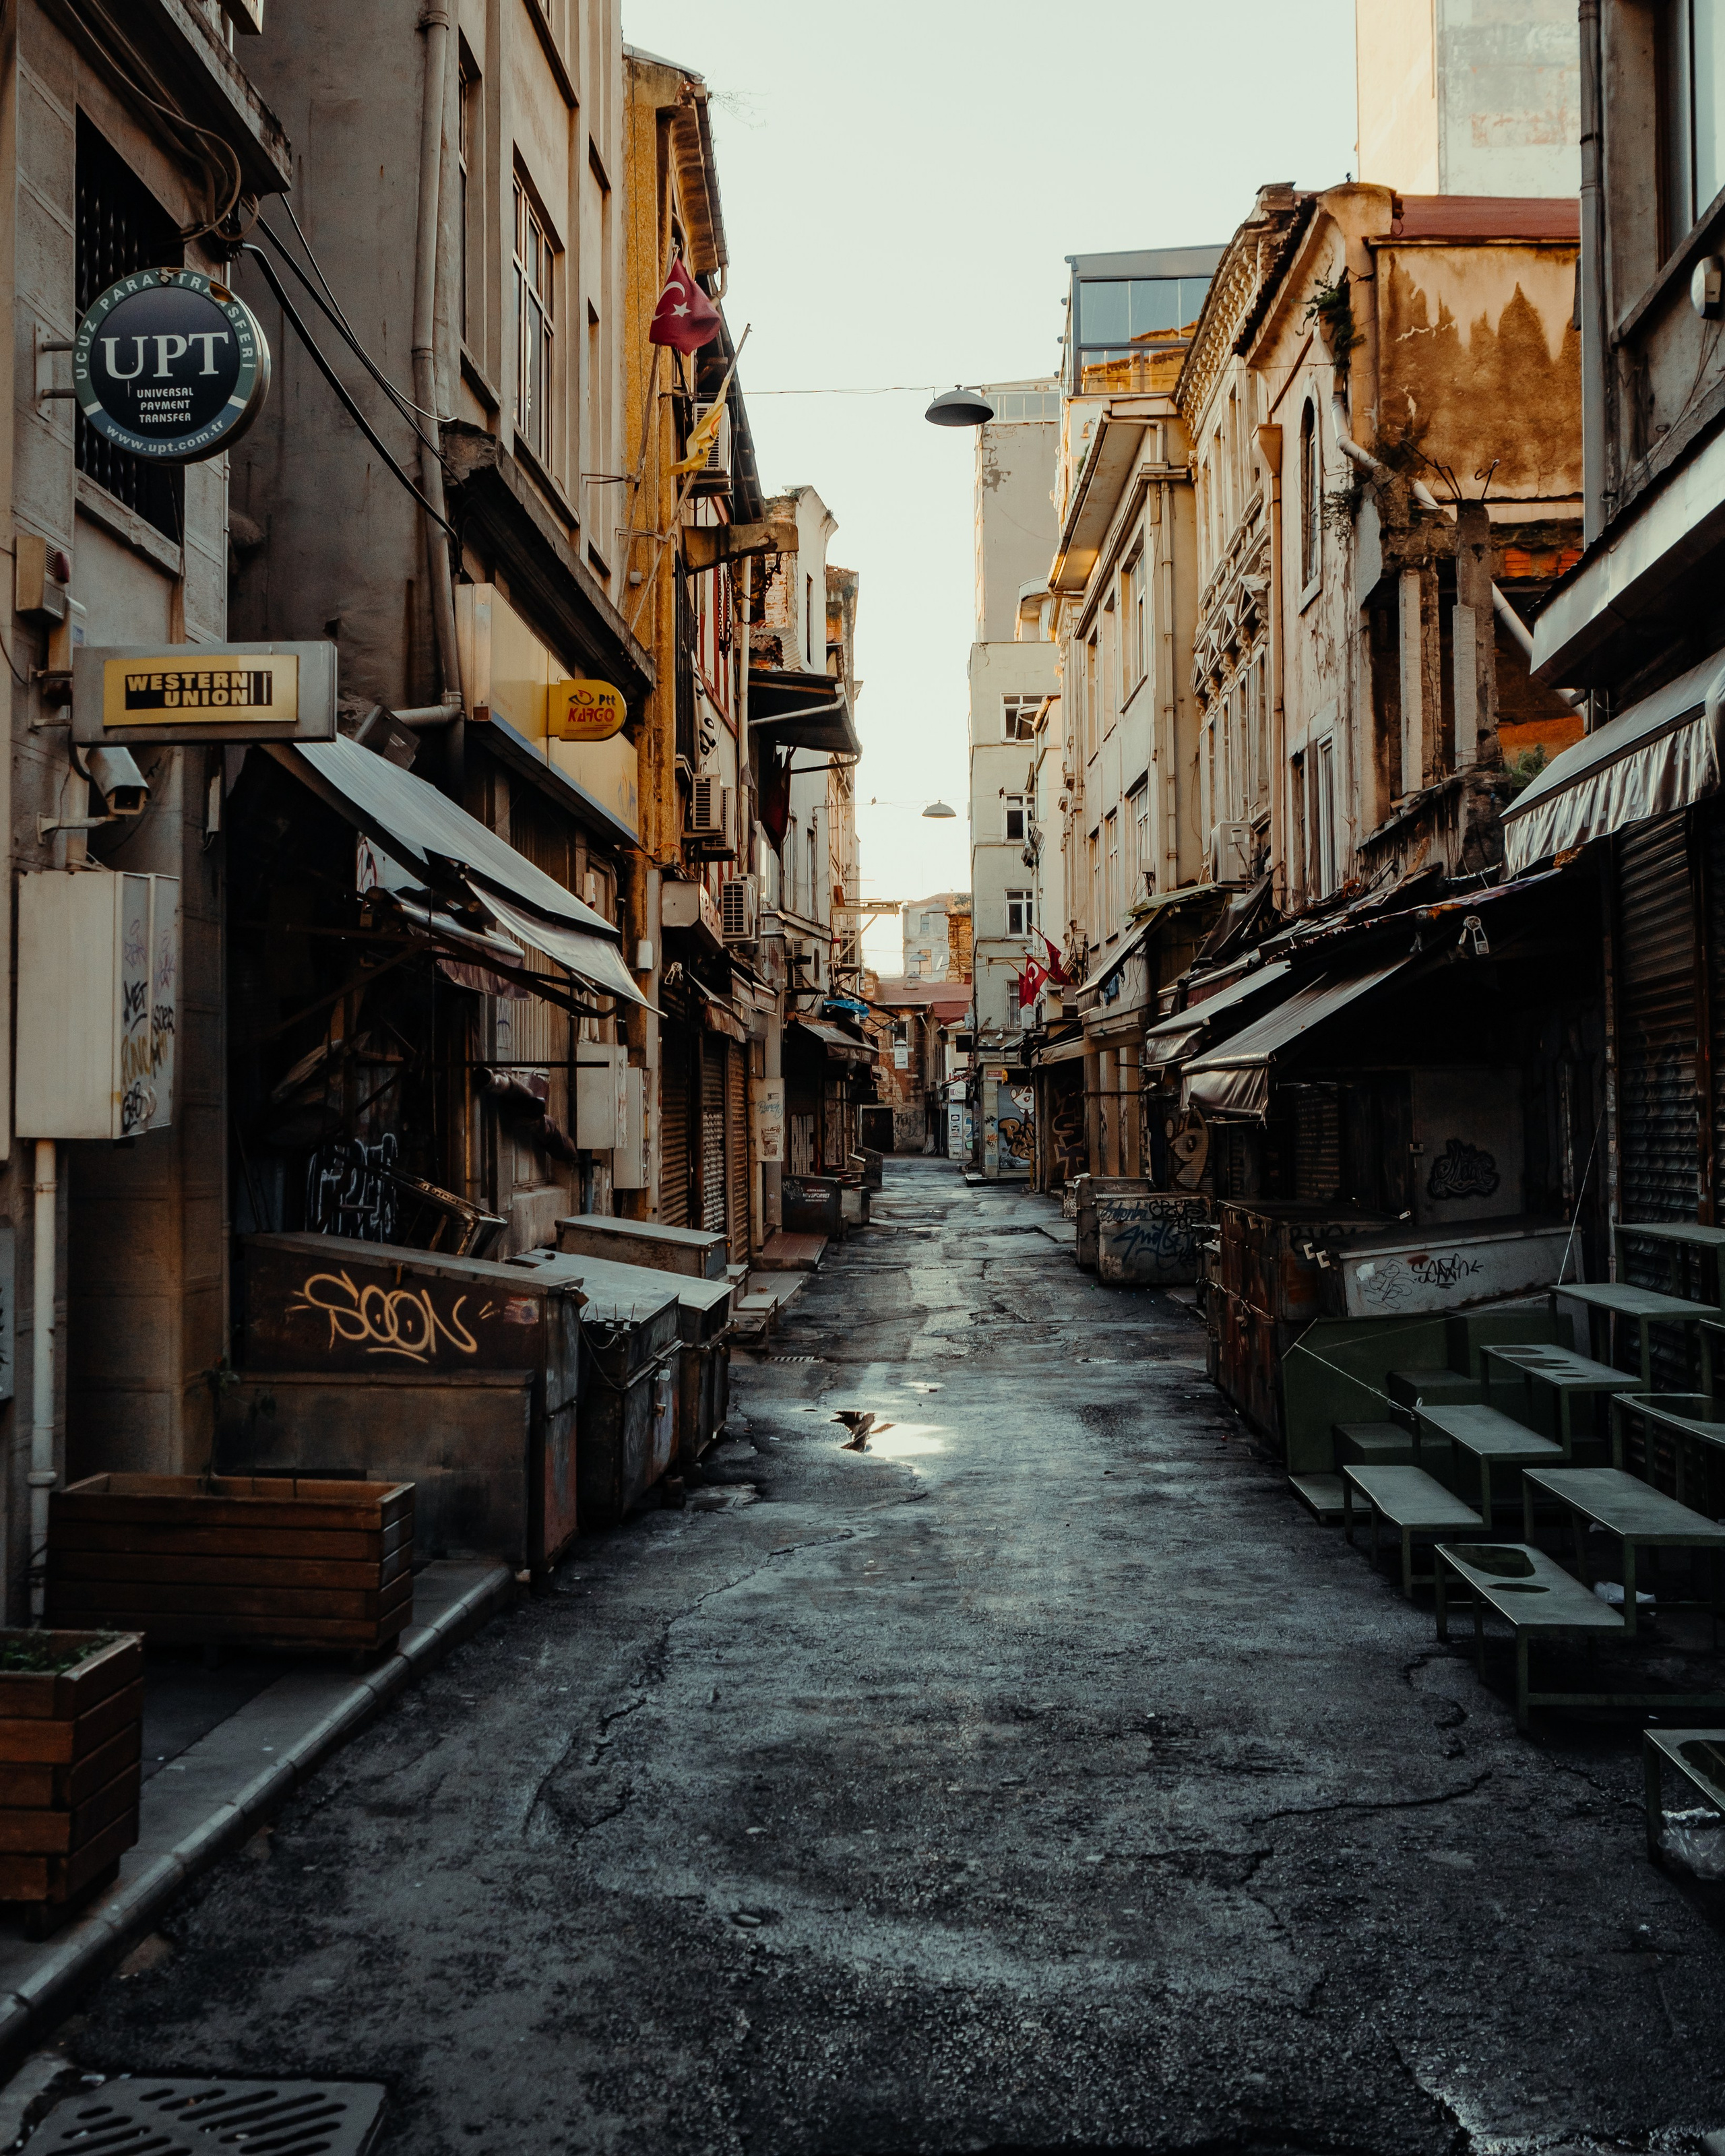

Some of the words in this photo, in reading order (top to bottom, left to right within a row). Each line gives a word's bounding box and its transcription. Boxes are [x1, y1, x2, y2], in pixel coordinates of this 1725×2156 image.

[75, 319, 97, 379] UCUZ
[100, 274, 154, 311] PARA
[178, 273, 256, 369] TRSFERİ
[100, 331, 229, 379] UPT
[137, 387, 193, 398] UNIVERSAL
[140, 400, 191, 410] PAYMENT
[139, 413, 191, 424] TRANSFER
[106, 419, 224, 454] www.upt.com.tr
[127, 672, 248, 692] WESTERN
[164, 689, 248, 707] UNION
[598, 693, 616, 706] Ptt
[568, 707, 615, 723] KARGO
[303, 1269, 477, 1354] SOON
